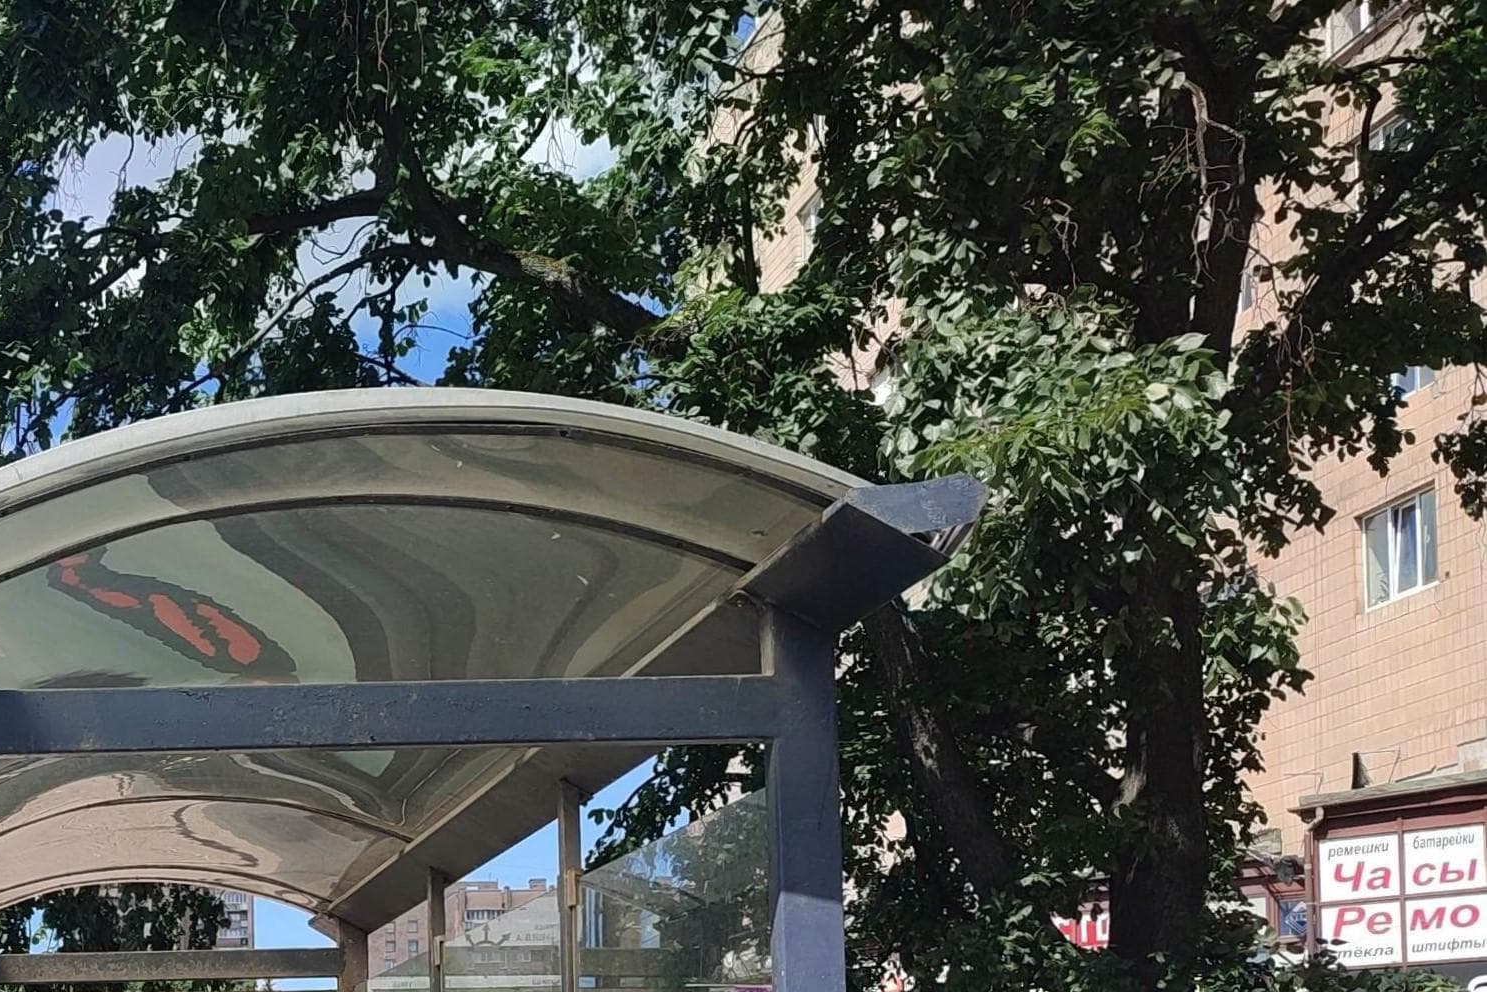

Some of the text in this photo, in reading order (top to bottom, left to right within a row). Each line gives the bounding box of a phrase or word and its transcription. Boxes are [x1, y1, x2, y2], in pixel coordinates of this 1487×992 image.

[1413, 833, 1475, 849] батарейки
[1328, 842, 1389, 860] ремешки
[1337, 946, 1394, 960] тёкла
[1412, 938, 1487, 953] штифты
